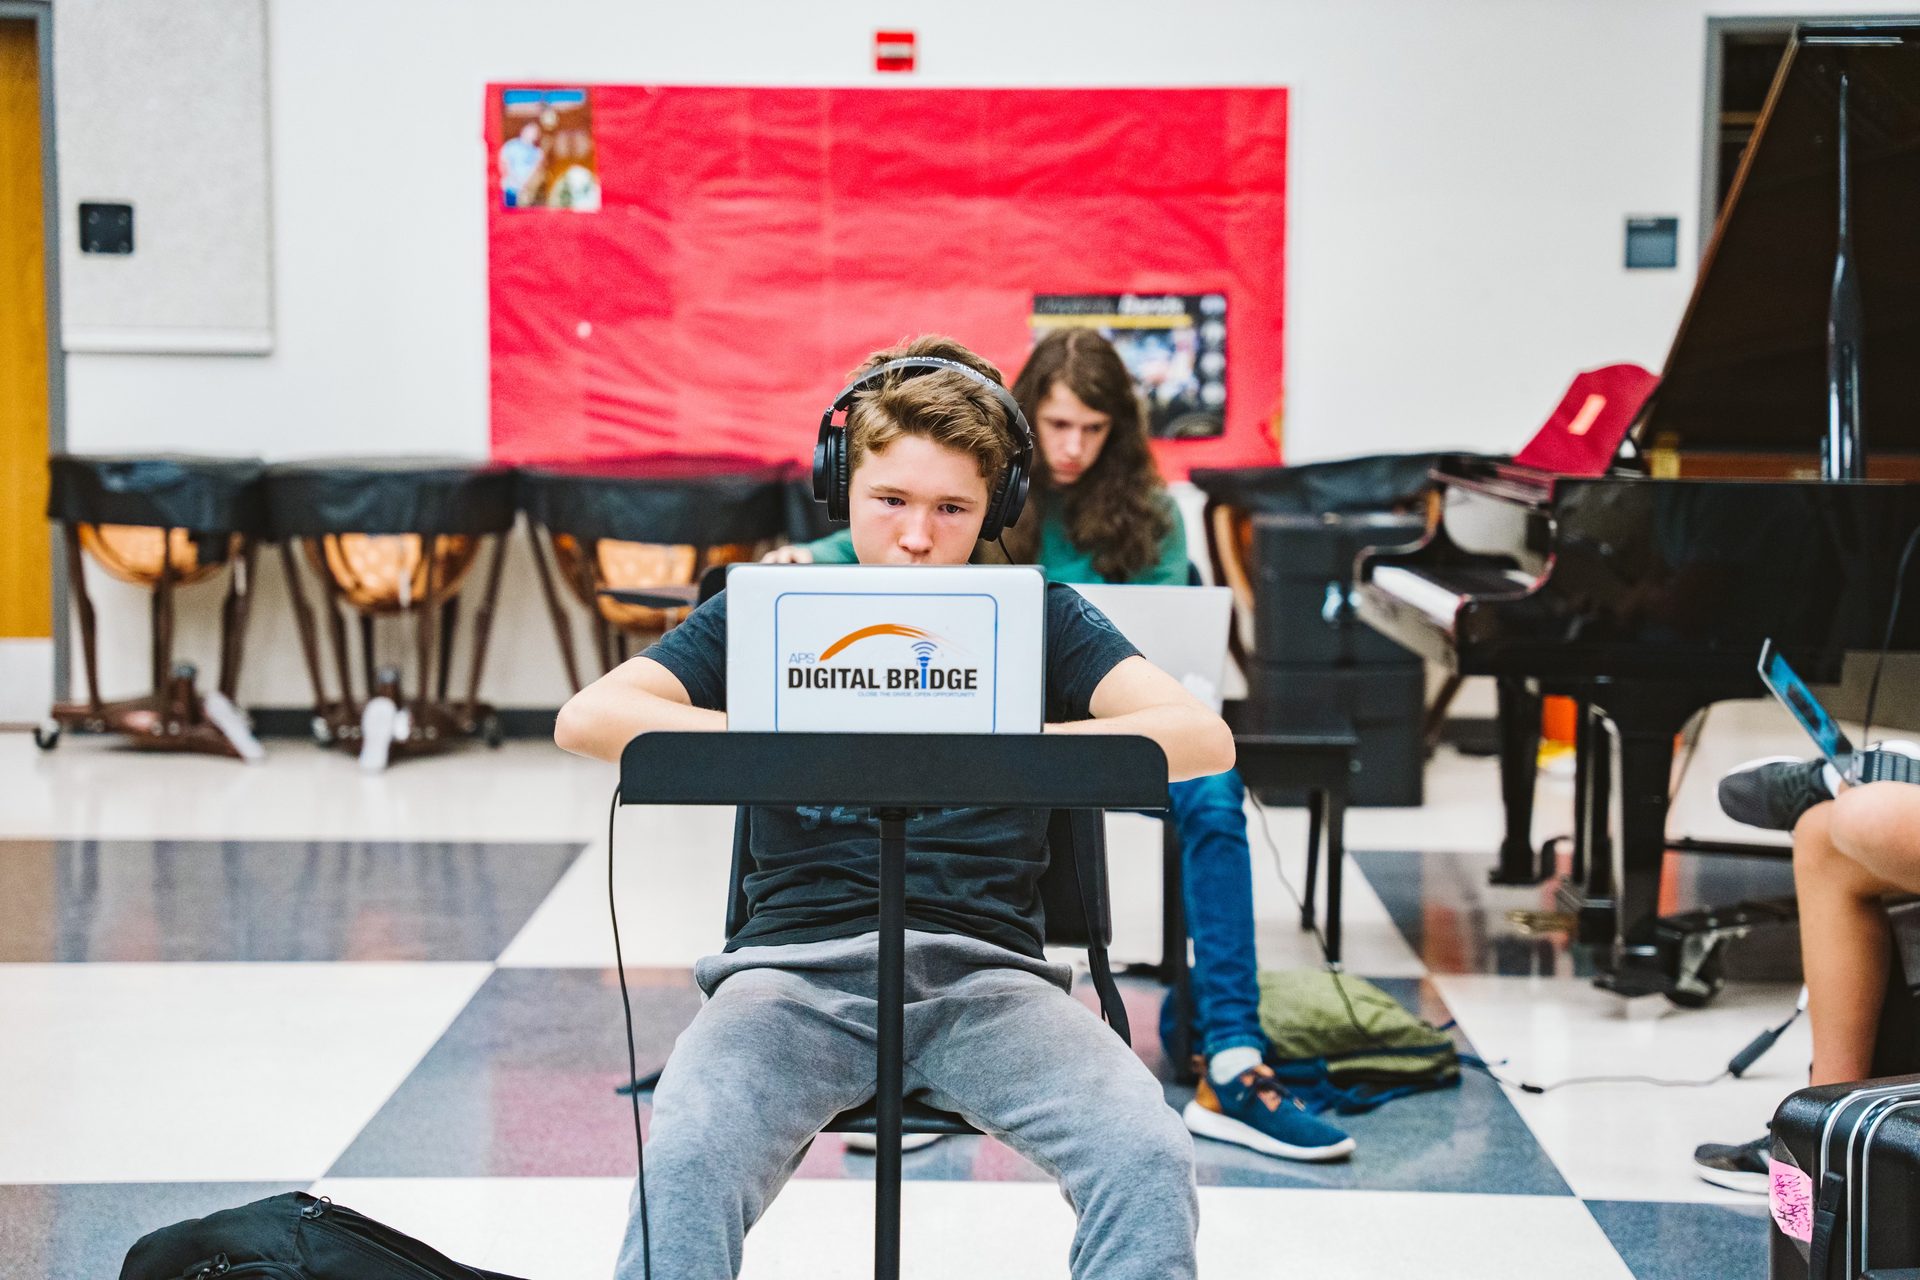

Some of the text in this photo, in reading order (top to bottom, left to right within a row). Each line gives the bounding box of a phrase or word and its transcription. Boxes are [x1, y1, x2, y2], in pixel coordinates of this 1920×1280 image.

[788, 652, 816, 664] APS
[787, 667, 978, 689] DIGITAL BRIDGE
